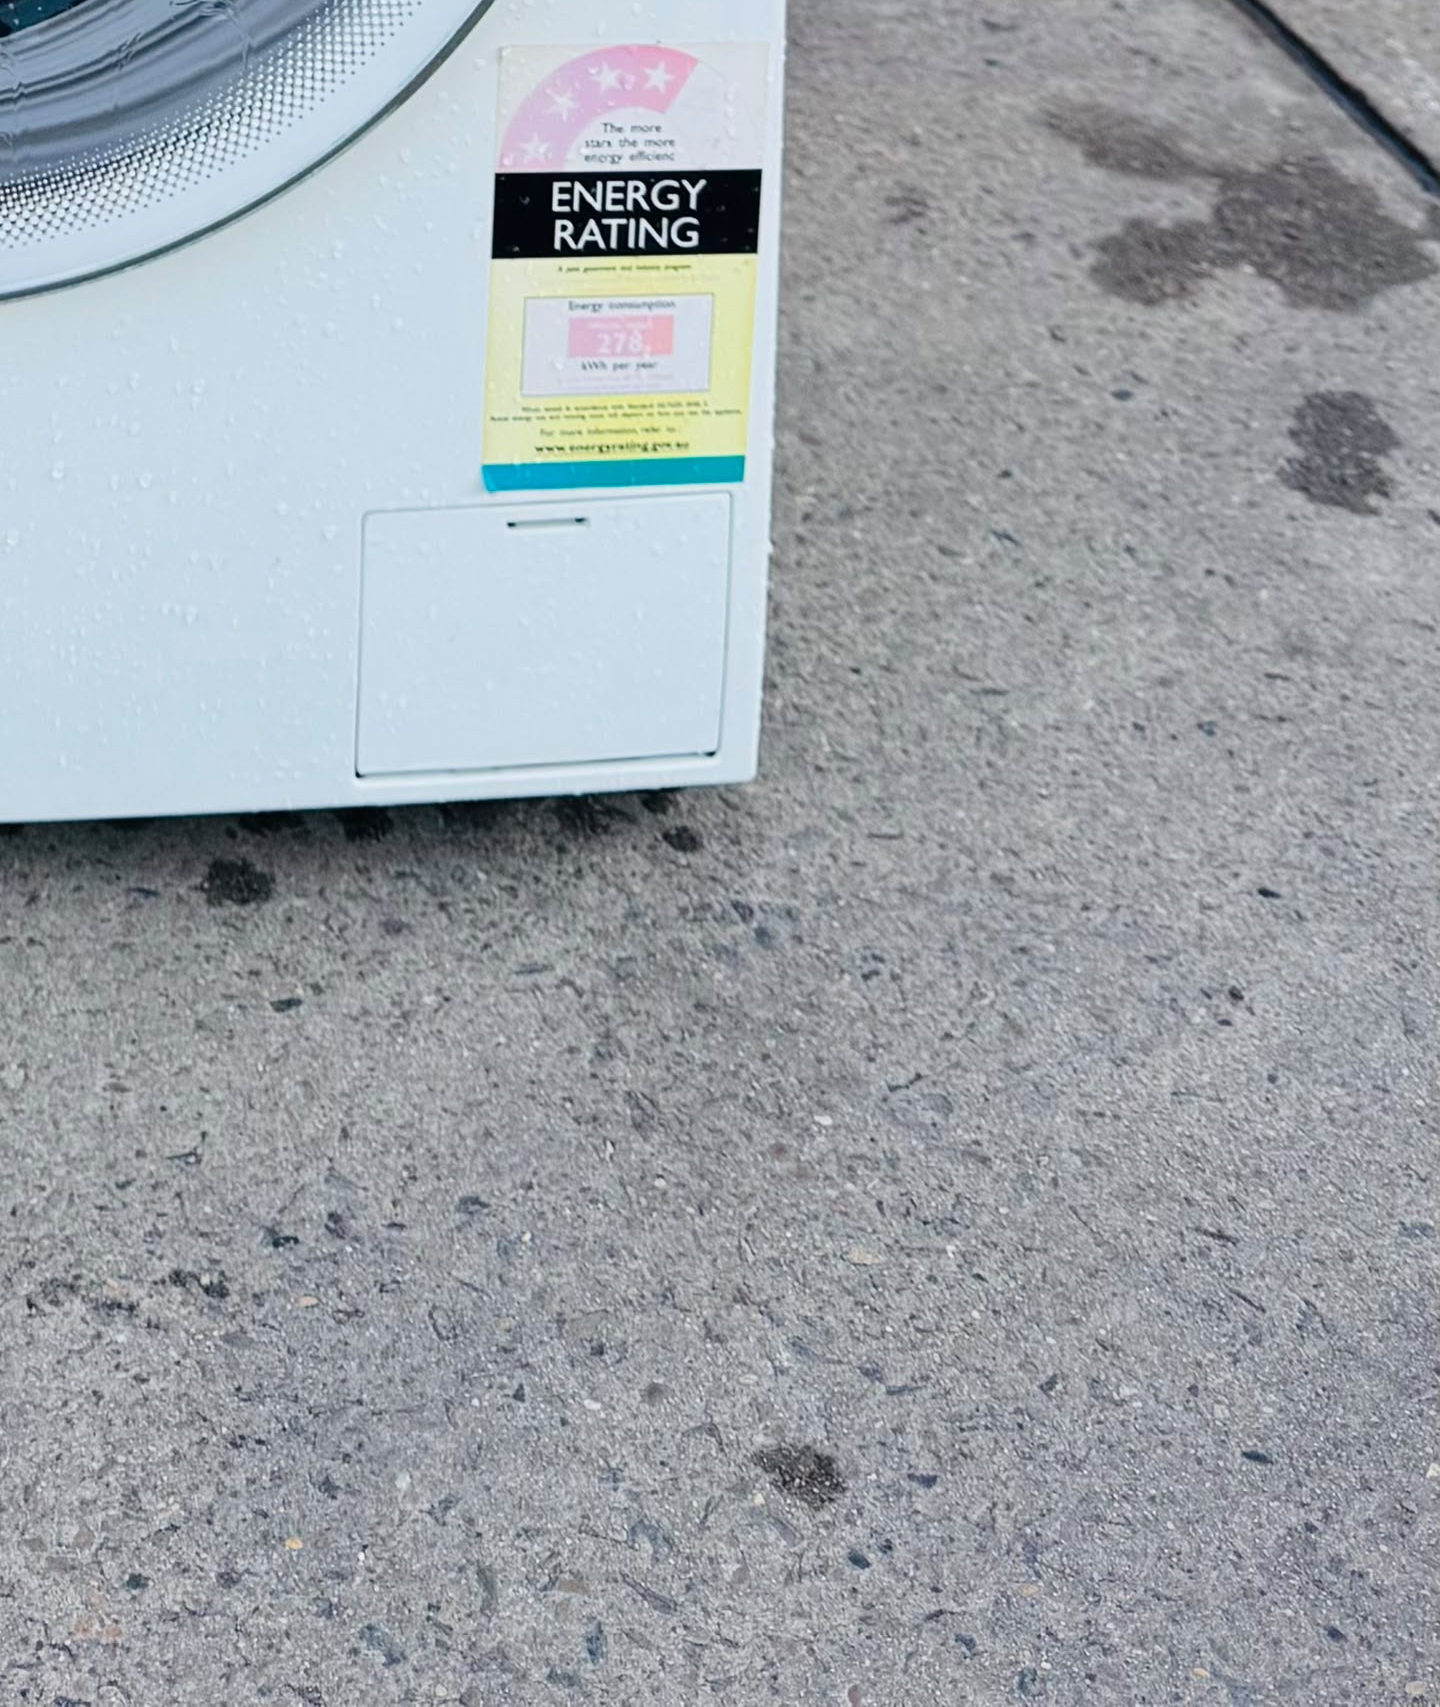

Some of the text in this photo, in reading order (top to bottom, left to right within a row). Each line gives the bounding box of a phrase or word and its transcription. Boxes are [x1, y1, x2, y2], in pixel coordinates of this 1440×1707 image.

[601, 122, 662, 133] The more
[619, 137, 638, 148] the
[644, 138, 676, 147] more
[551, 179, 707, 213] ENERGY
[553, 217, 700, 250] RATING
[568, 301, 603, 312] Energy
